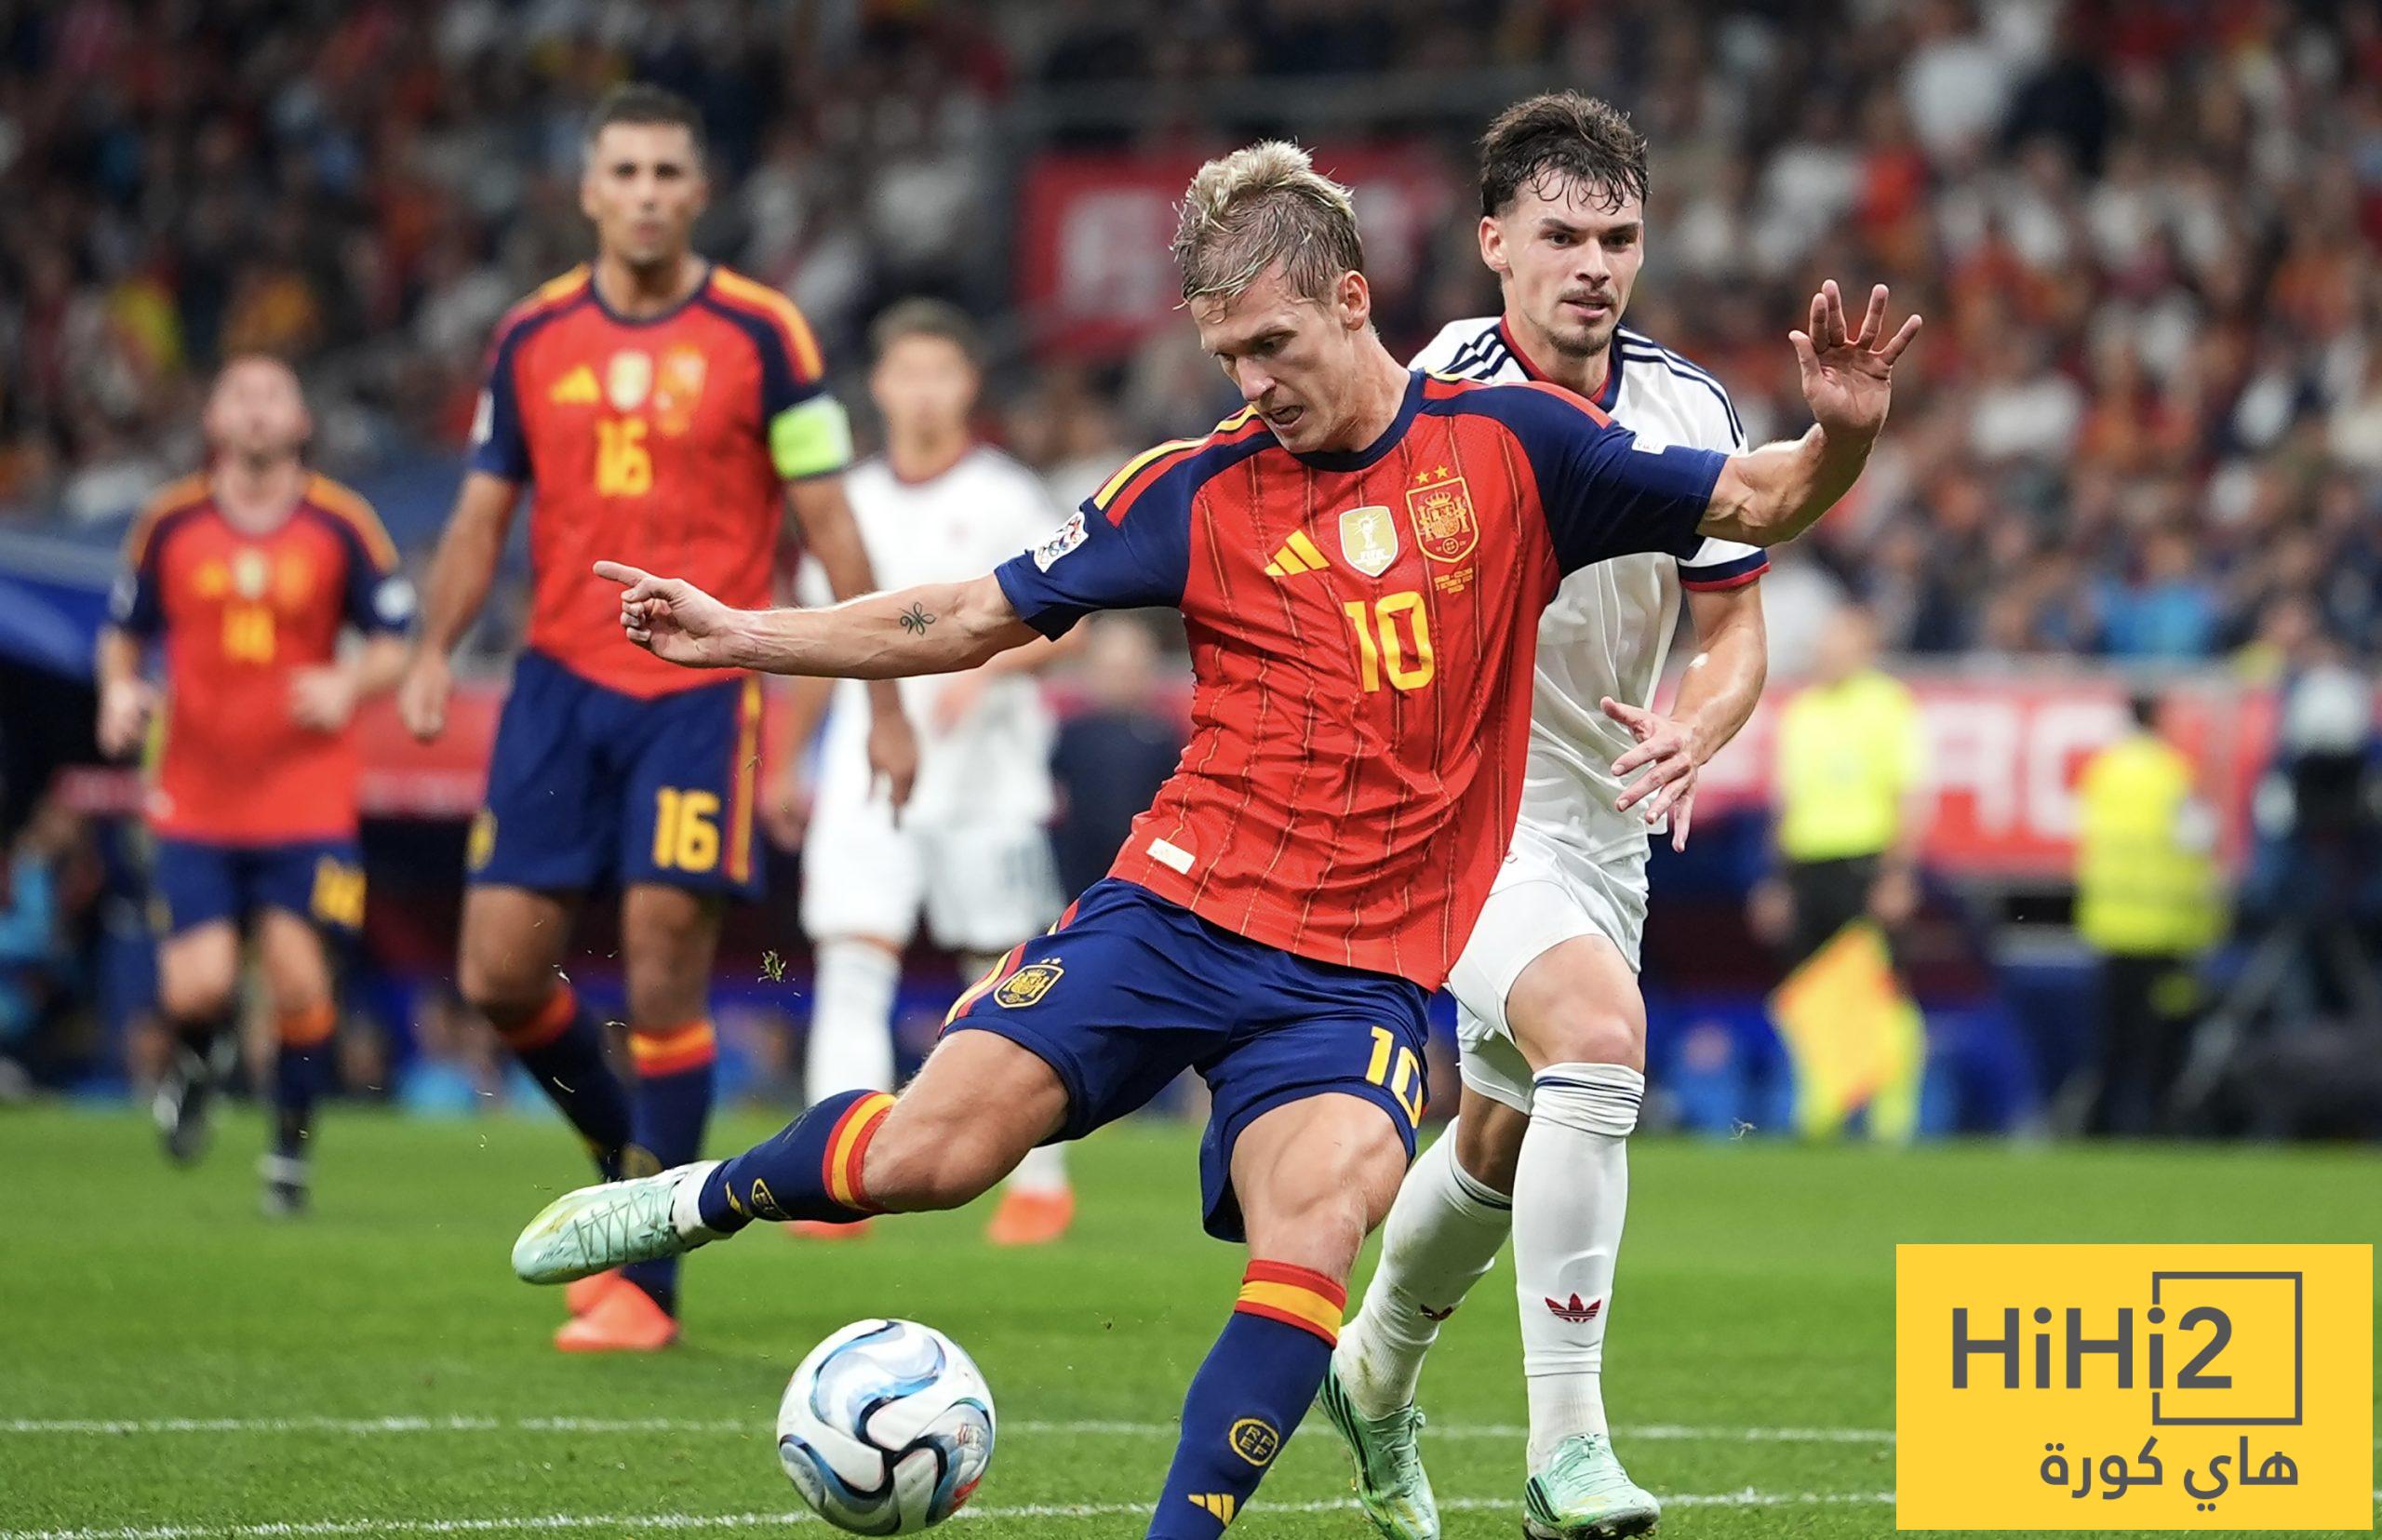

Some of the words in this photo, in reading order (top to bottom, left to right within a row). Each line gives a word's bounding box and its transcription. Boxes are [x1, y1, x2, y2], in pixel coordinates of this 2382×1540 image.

[596, 417, 651, 496] 16
[1344, 591, 1435, 692] 10
[654, 785, 721, 871] 16
[1365, 1025, 1424, 1130] 10
